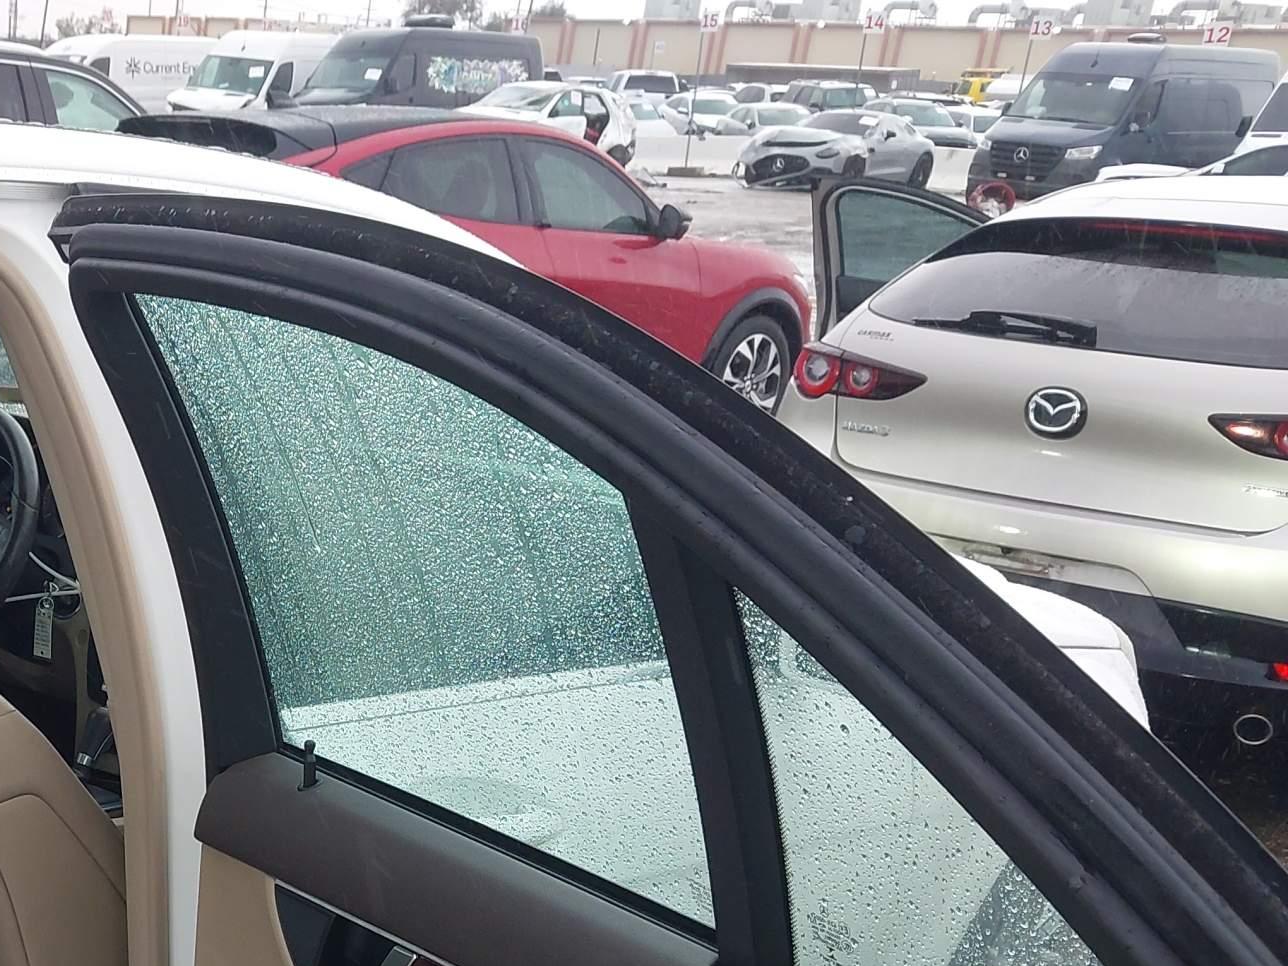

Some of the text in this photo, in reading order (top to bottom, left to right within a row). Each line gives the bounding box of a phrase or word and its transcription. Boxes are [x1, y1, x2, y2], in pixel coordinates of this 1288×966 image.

[702, 13, 718, 28] 15
[864, 15, 883, 29] 14
[1031, 20, 1053, 36] 13
[1203, 26, 1230, 44] 12
[143, 60, 181, 74] Current
